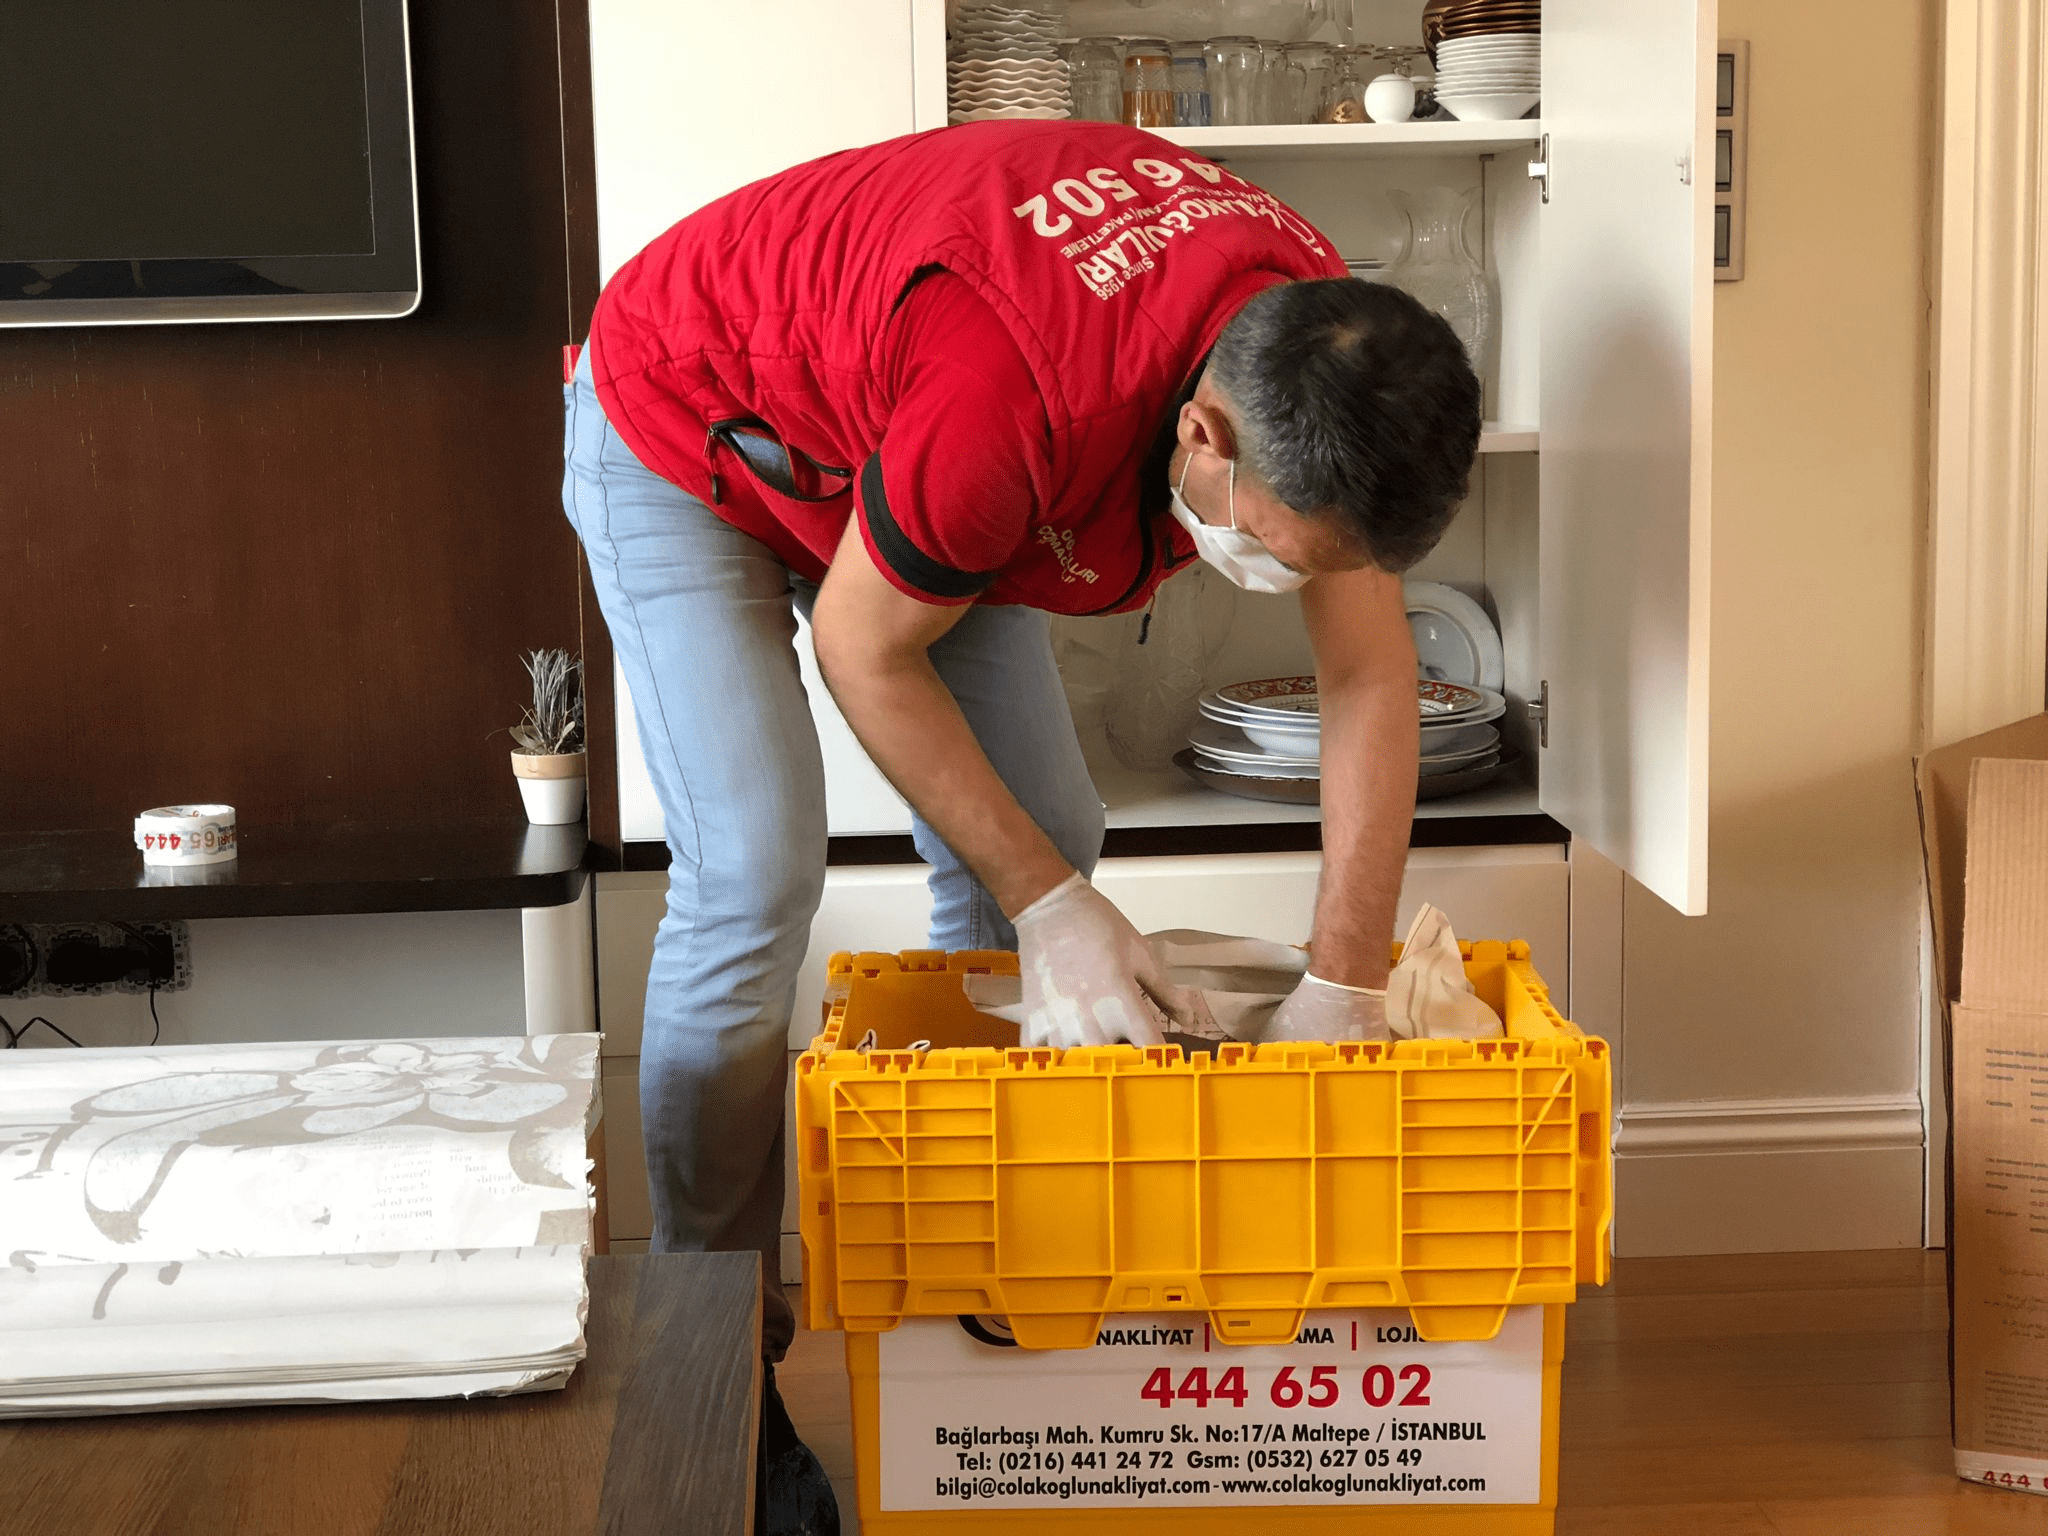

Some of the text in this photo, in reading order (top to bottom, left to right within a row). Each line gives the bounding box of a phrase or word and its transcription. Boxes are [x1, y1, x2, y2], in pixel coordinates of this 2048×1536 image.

[1095, 256, 1155, 301] Since 1956
[1141, 1364, 1432, 1408] 444 65 02
[936, 1426, 1040, 1450] Bağlarbaşı
[1046, 1425, 1094, 1444] Mah.
[1101, 1426, 1164, 1443] Kumru
[1170, 1424, 1199, 1443] Sk.
[1206, 1424, 1286, 1444] No:17/A
[1292, 1423, 1370, 1446] Maltepe
[1391, 1418, 1486, 1441] İSTANBUL
[957, 1449, 1423, 1475] Tel: (0216) 441 24 72 Gsm: (0532) 627 05 49
[1222, 1472, 1486, 1497] www.colakoglunakliyat.com
[1982, 1471, 2031, 1488] 444
